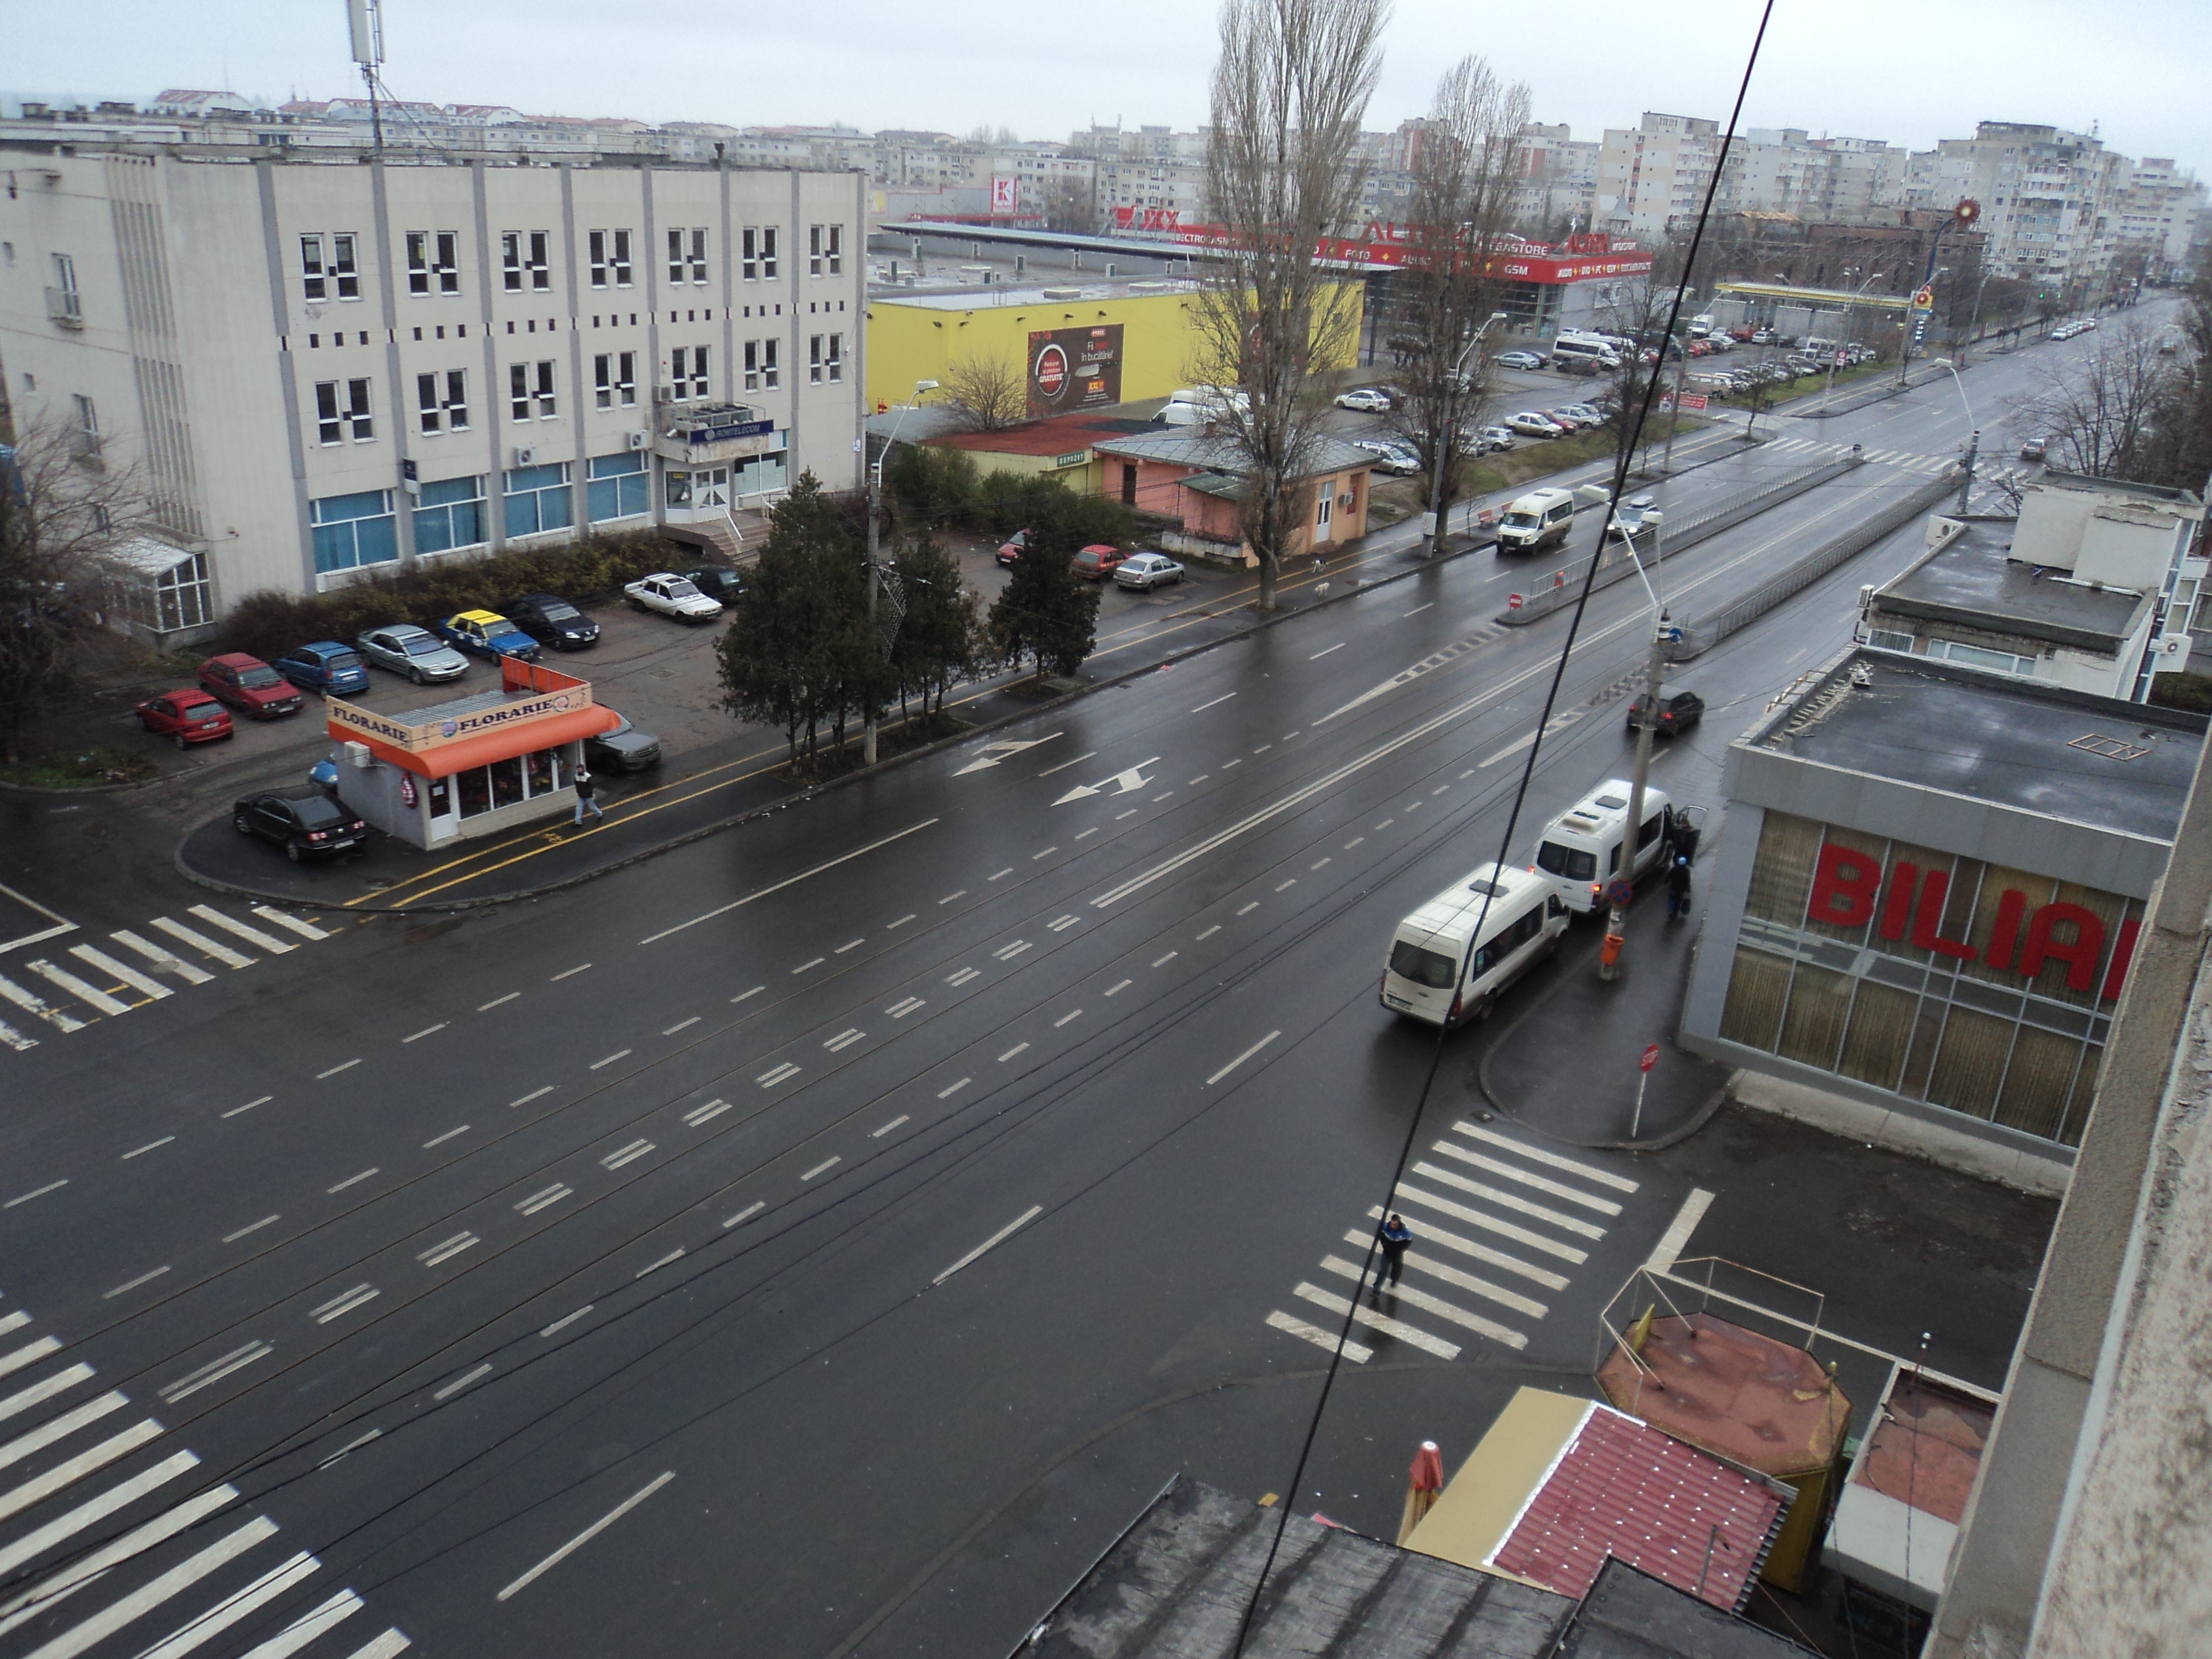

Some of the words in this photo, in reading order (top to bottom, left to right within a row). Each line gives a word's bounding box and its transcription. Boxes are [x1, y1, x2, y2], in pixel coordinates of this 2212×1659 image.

[1505, 265, 1528, 275] GSM
[716, 425, 760, 437] ROMTELECOM
[1060, 453, 1083, 464] DEPOZIT
[460, 700, 553, 731] FLORARIE
[333, 706, 408, 742] FLORARIE
[1641, 1050, 1658, 1067] STOP
